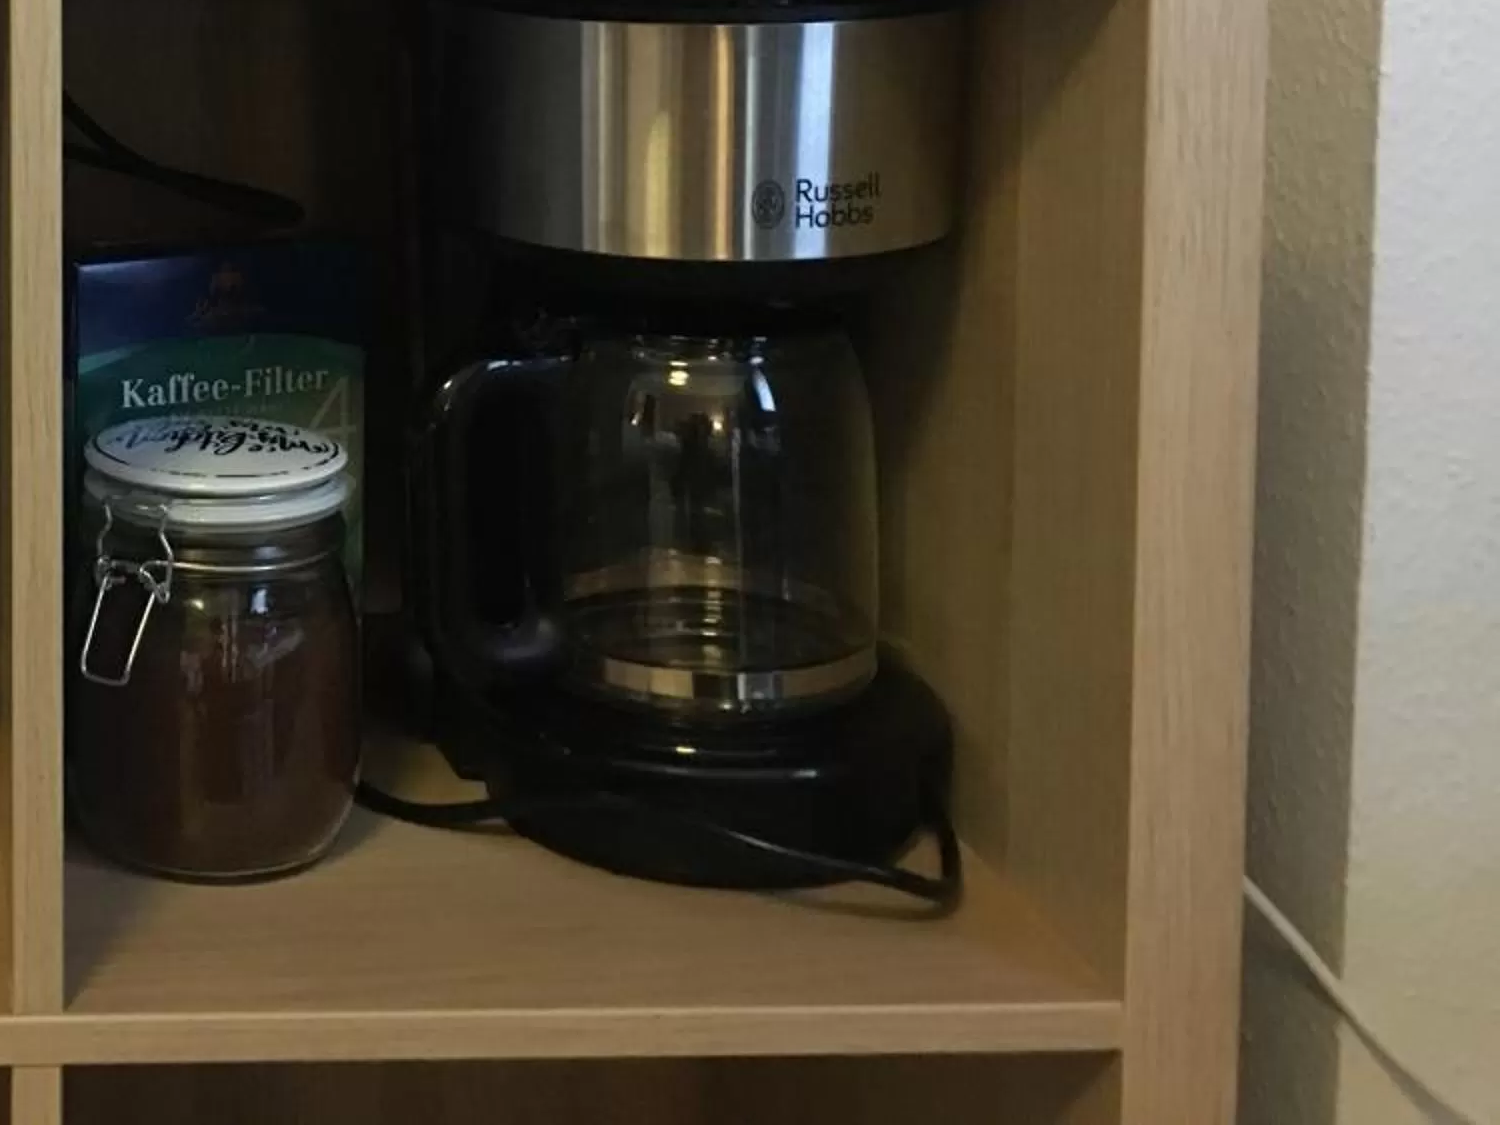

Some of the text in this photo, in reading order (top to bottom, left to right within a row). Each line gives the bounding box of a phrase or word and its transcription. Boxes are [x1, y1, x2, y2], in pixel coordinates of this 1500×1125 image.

[796, 171, 880, 203] Russell
[796, 204, 874, 229] Hobbs
[121, 365, 329, 409] Kaffee-Filter
